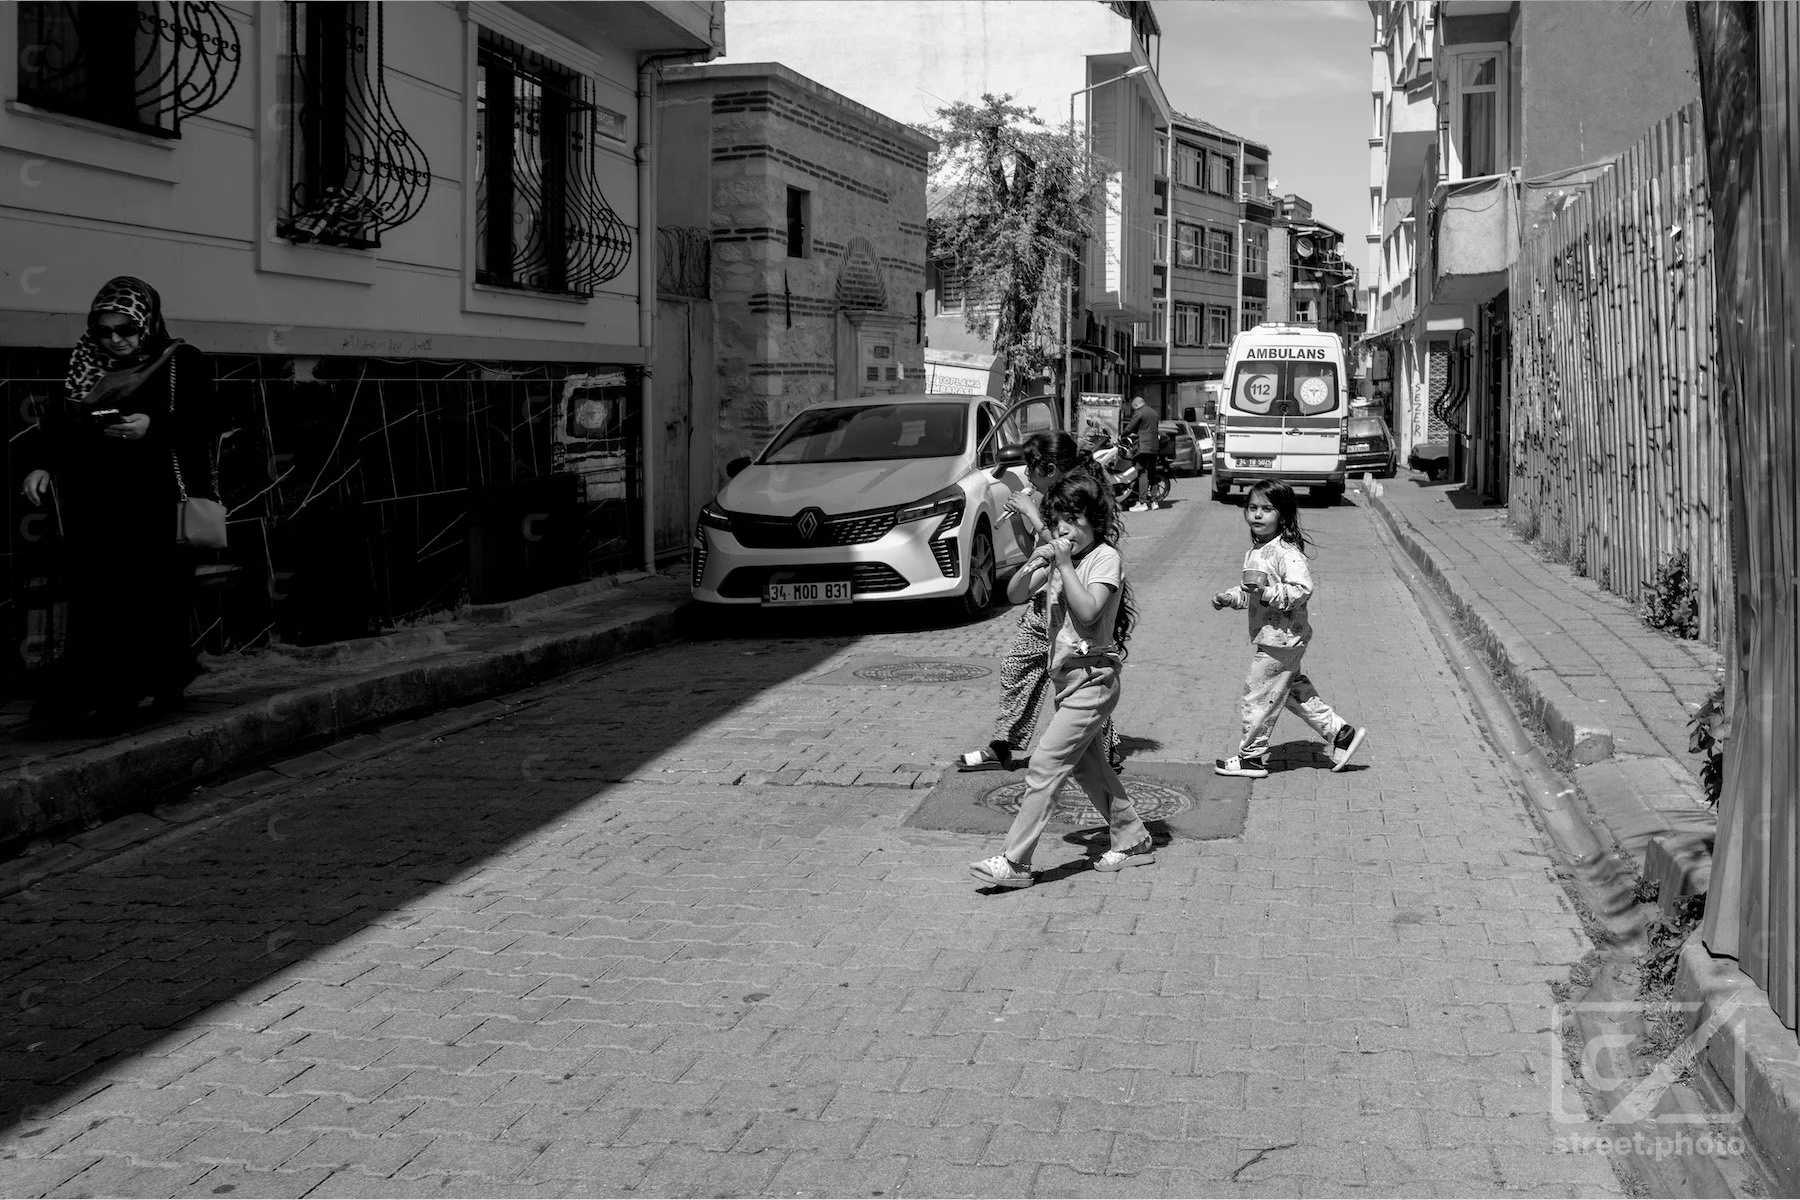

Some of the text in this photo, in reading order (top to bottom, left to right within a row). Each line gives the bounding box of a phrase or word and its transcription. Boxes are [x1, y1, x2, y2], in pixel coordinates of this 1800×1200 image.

[1246, 348, 1326, 360] AMBULANS
[938, 375, 981, 390] TOPLAMA
[1251, 384, 1271, 396] 112
[1413, 383, 1422, 437] SEZER
[770, 585, 787, 601] 34
[793, 584, 818, 600] MOD
[825, 583, 848, 599] 831
